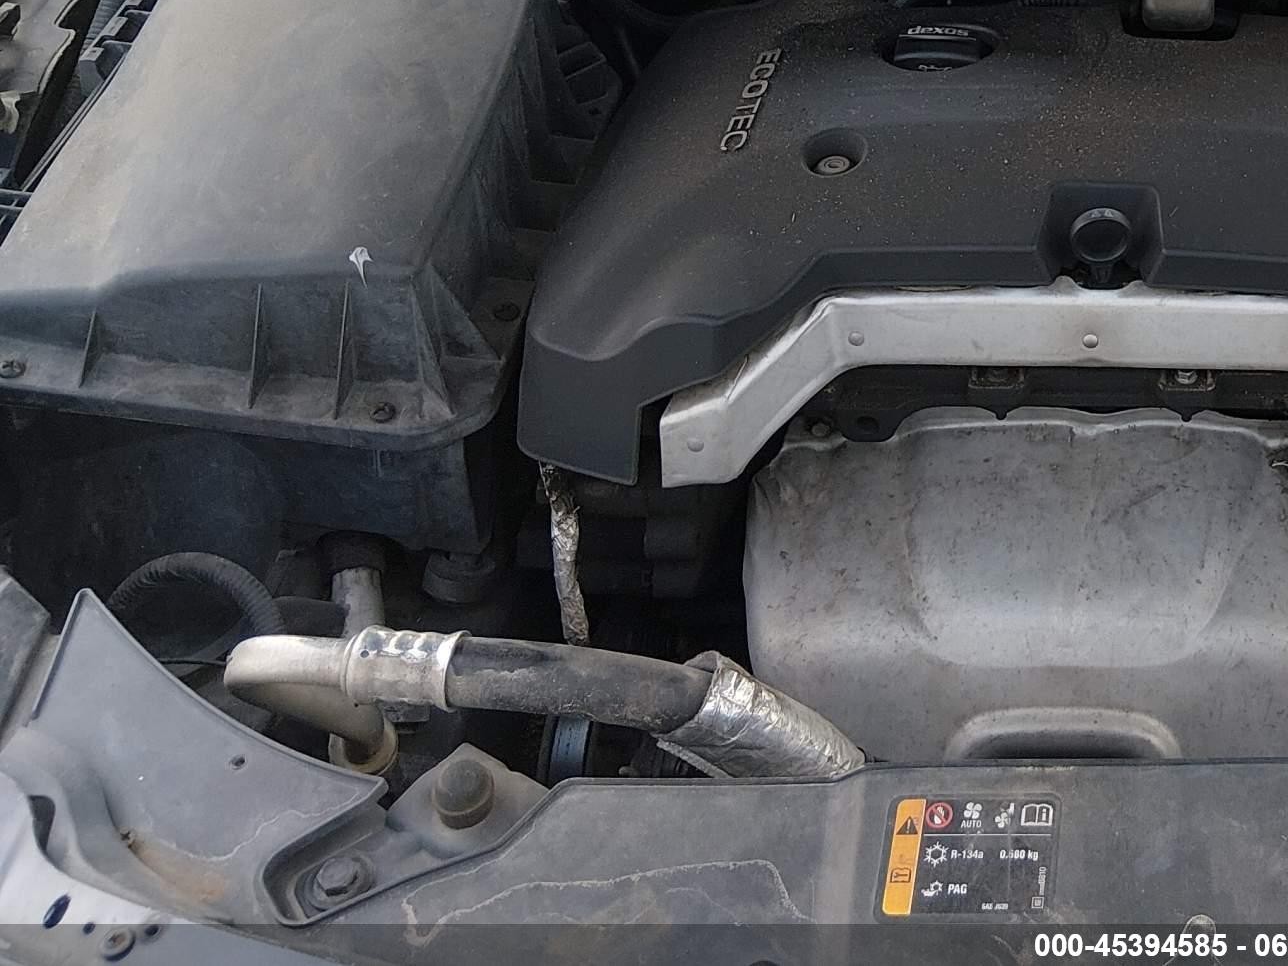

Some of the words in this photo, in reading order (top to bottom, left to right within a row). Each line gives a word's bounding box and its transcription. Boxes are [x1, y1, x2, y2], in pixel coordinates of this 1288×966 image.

[907, 25, 969, 37] dexos
[720, 49, 781, 152] ECOTEC
[960, 820, 982, 829] AUTO
[951, 849, 984, 859] R-134a
[1028, 849, 1039, 862] kg
[948, 884, 968, 895] PAG
